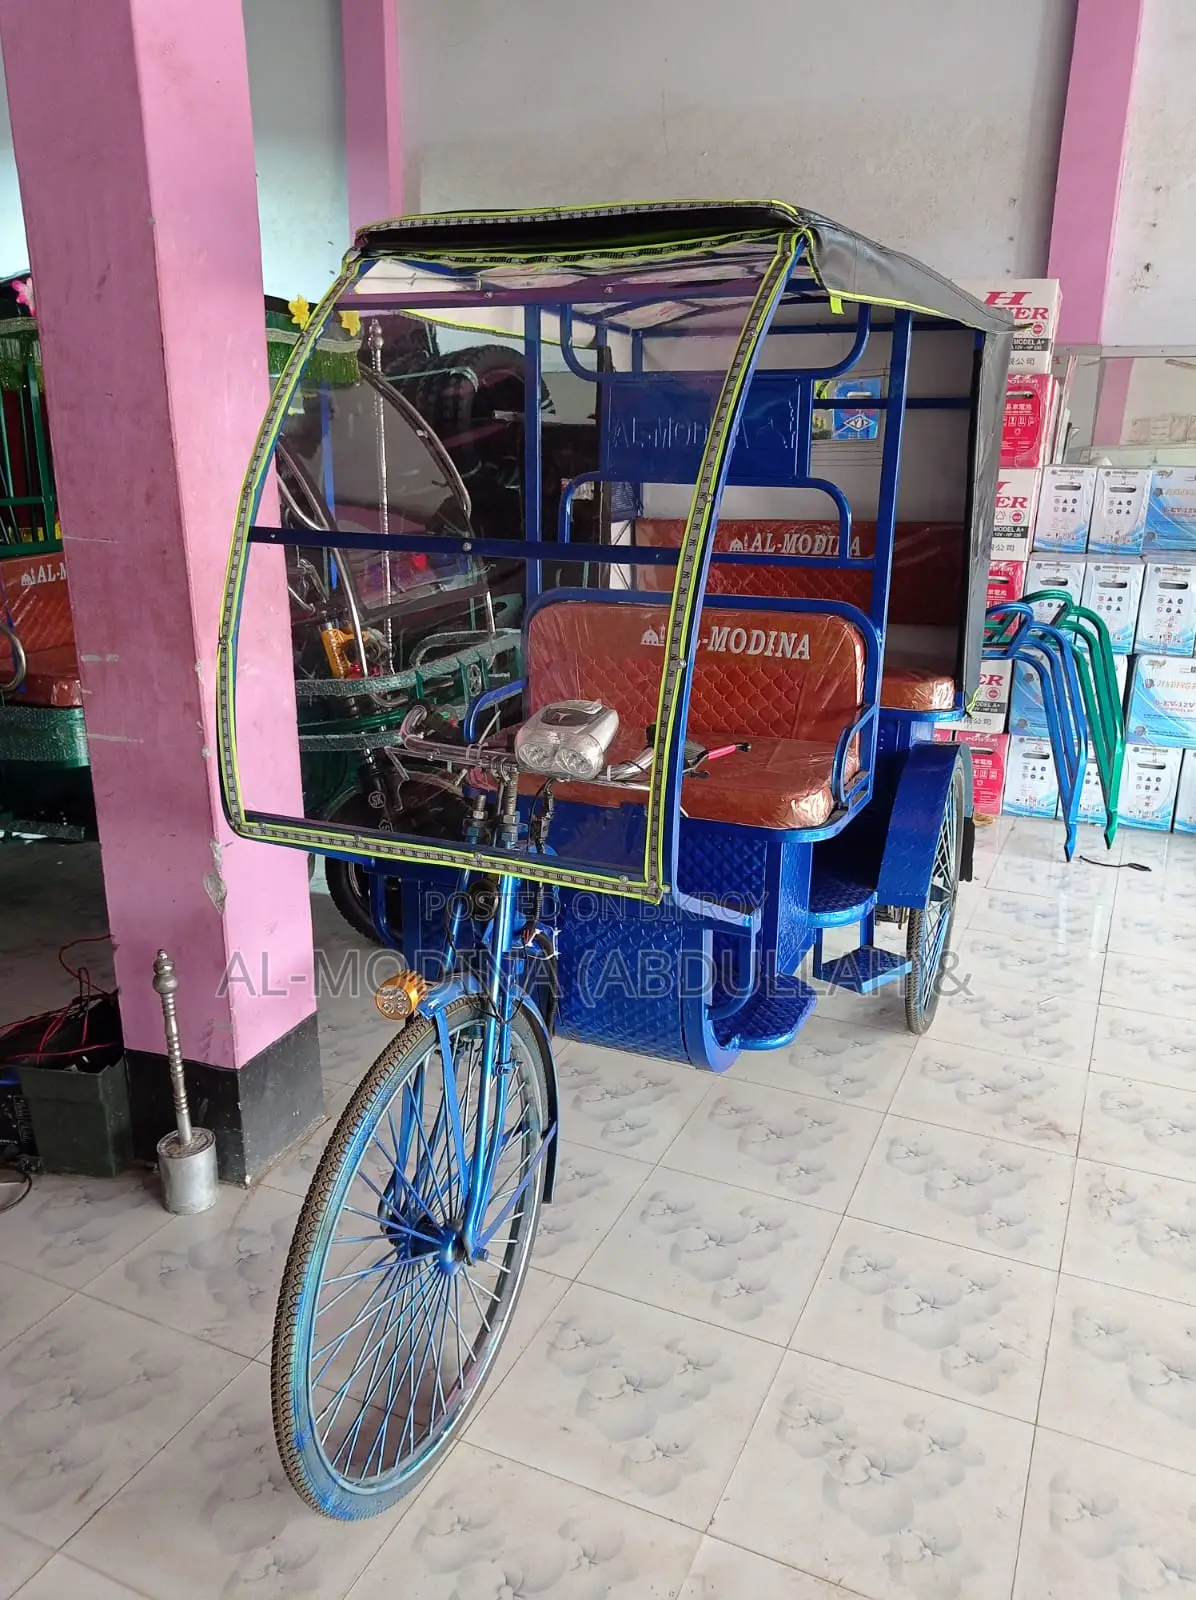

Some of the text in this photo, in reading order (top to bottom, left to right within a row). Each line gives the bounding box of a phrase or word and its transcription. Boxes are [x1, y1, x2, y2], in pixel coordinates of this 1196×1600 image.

[984, 291, 1032, 306] H
[993, 544, 1015, 552] 公司
[696, 626, 811, 660] -MODINA
